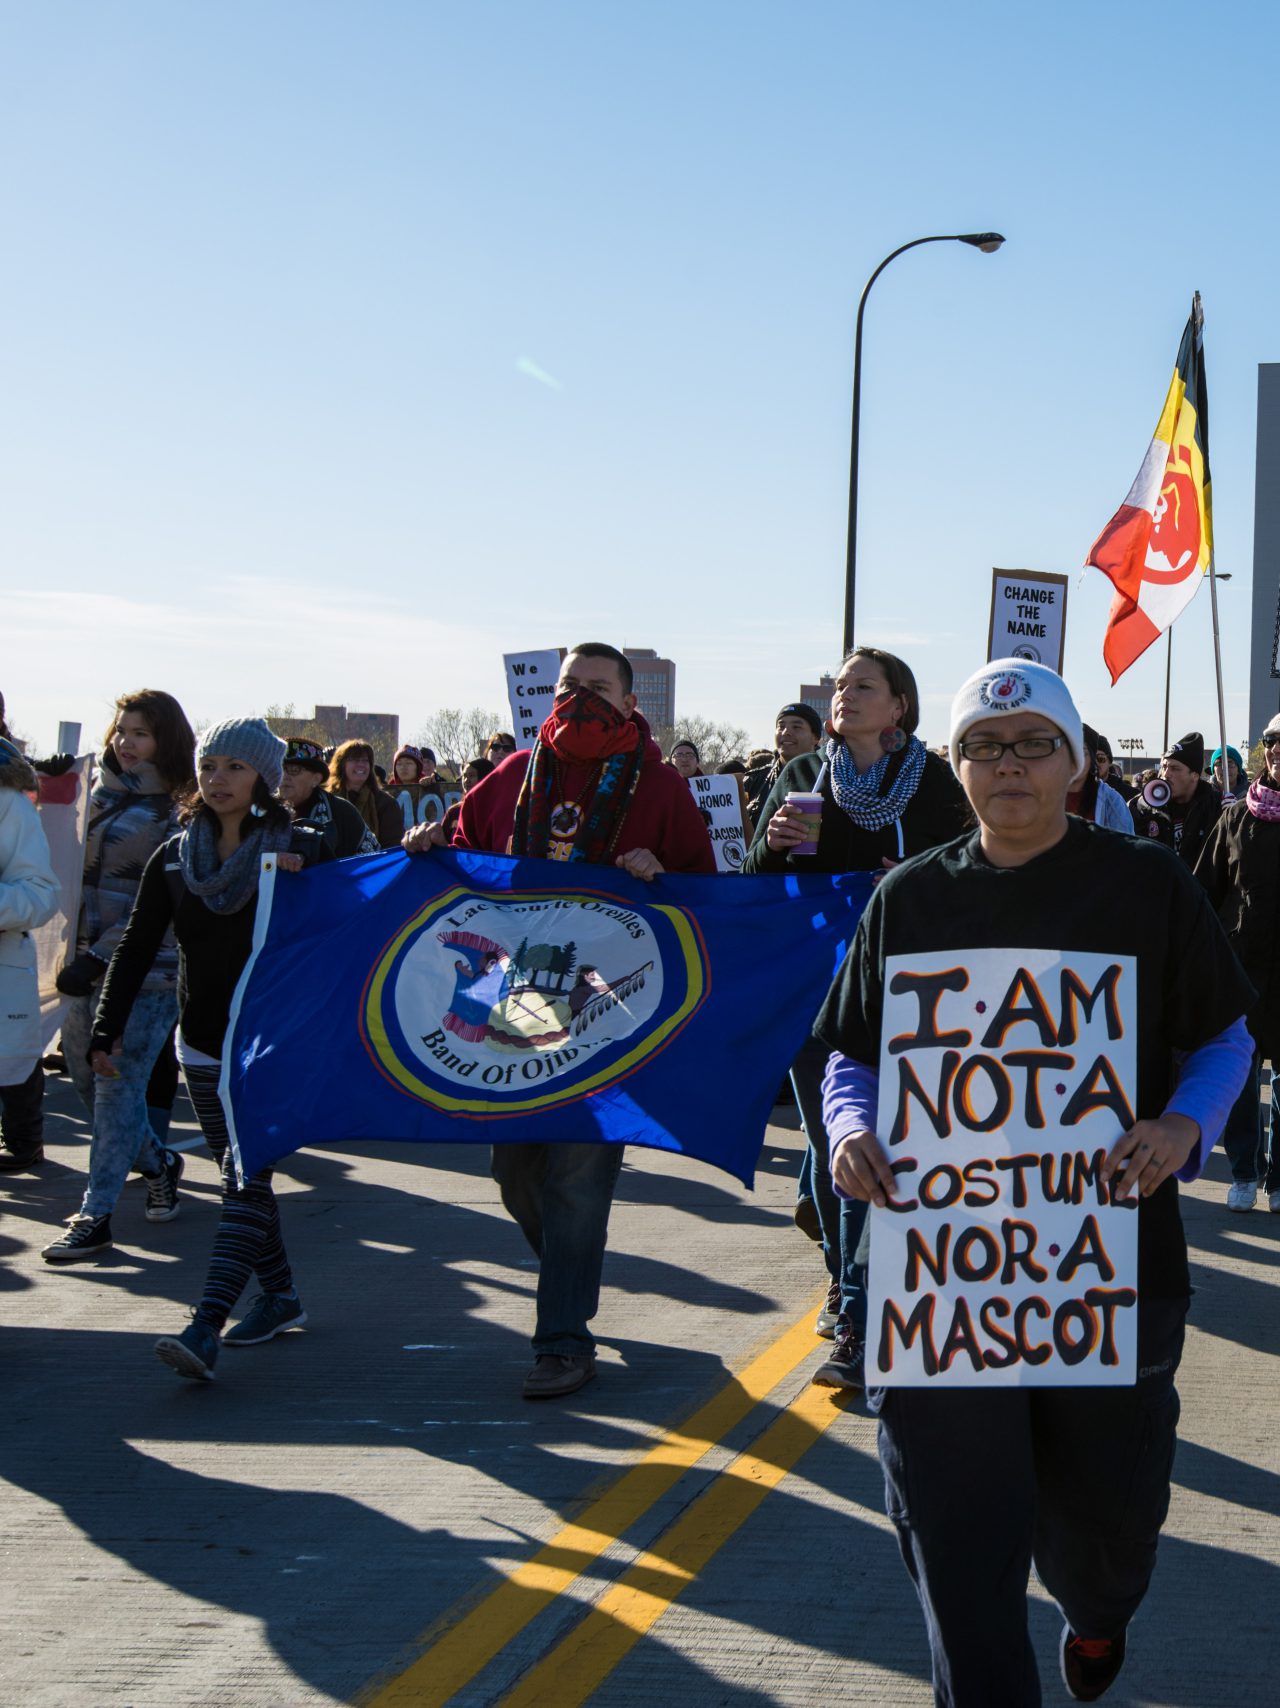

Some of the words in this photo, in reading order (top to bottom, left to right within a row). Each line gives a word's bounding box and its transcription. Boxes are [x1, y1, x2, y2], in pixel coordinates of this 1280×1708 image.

[1004, 586, 1055, 604] CHANGE
[1016, 605, 1040, 619] THE
[1007, 621, 1046, 638] NAME
[512, 664, 538, 676] We
[516, 685, 554, 697] Come
[519, 706, 533, 718] in
[523, 726, 538, 739] PE
[695, 779, 710, 792] NO
[700, 793, 734, 809] HONOR
[447, 903, 489, 928] Lac
[580, 900, 646, 940] Oreilles
[888, 966, 972, 1055] I
[980, 964, 1124, 1048] AM
[421, 1027, 479, 1077] Band
[481, 1063, 516, 1085] Of
[521, 1037, 612, 1080] Ojib
[889, 1049, 1076, 1146] NOT
[1060, 1054, 1137, 1133] A
[882, 1148, 1139, 1213] COSTUME
[905, 1218, 1048, 1292] NOR
[1056, 1214, 1115, 1282] A
[877, 1287, 1137, 1377] MASCOT
